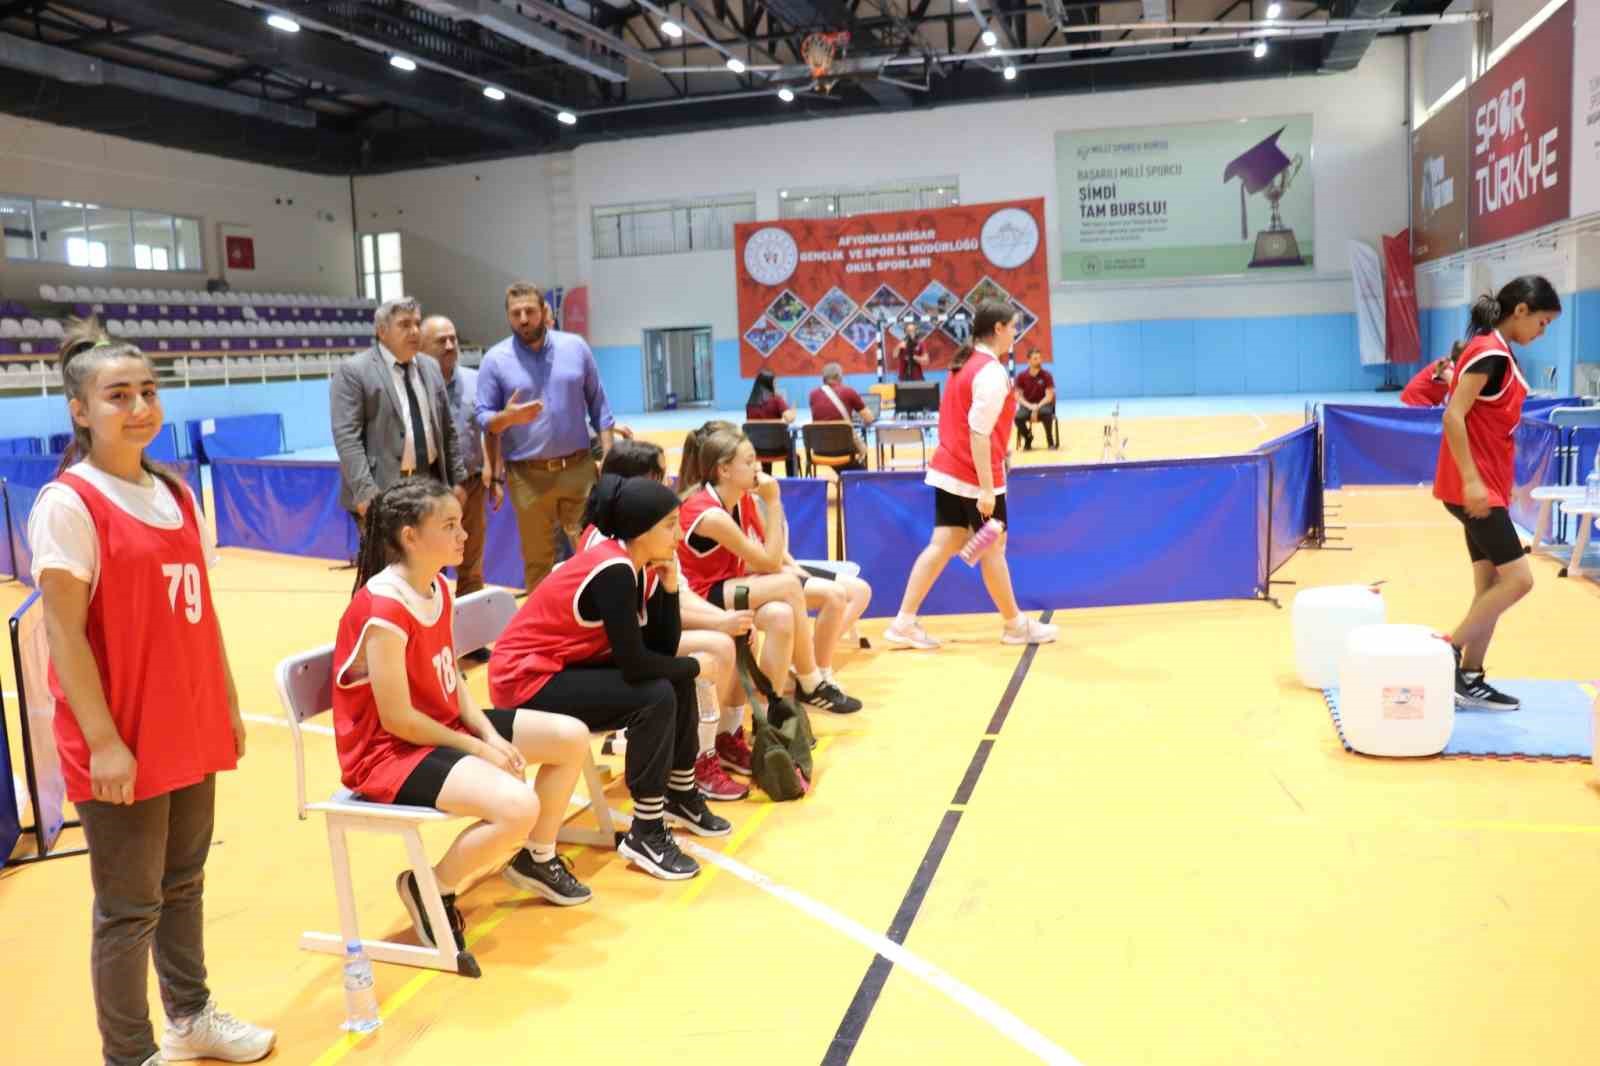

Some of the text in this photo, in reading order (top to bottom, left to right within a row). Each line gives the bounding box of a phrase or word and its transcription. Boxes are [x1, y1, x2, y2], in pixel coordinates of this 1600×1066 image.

[1475, 77, 1526, 155] SPOR
[1475, 127, 1559, 215] TÜRKİYE
[1080, 200, 1168, 218] TAM BURSLU!
[845, 257, 933, 274] OKUL SPORLARI
[849, 248, 863, 260] VE
[865, 247, 895, 259] SPOR
[161, 563, 202, 625] 79
[431, 645, 457, 704] 78
